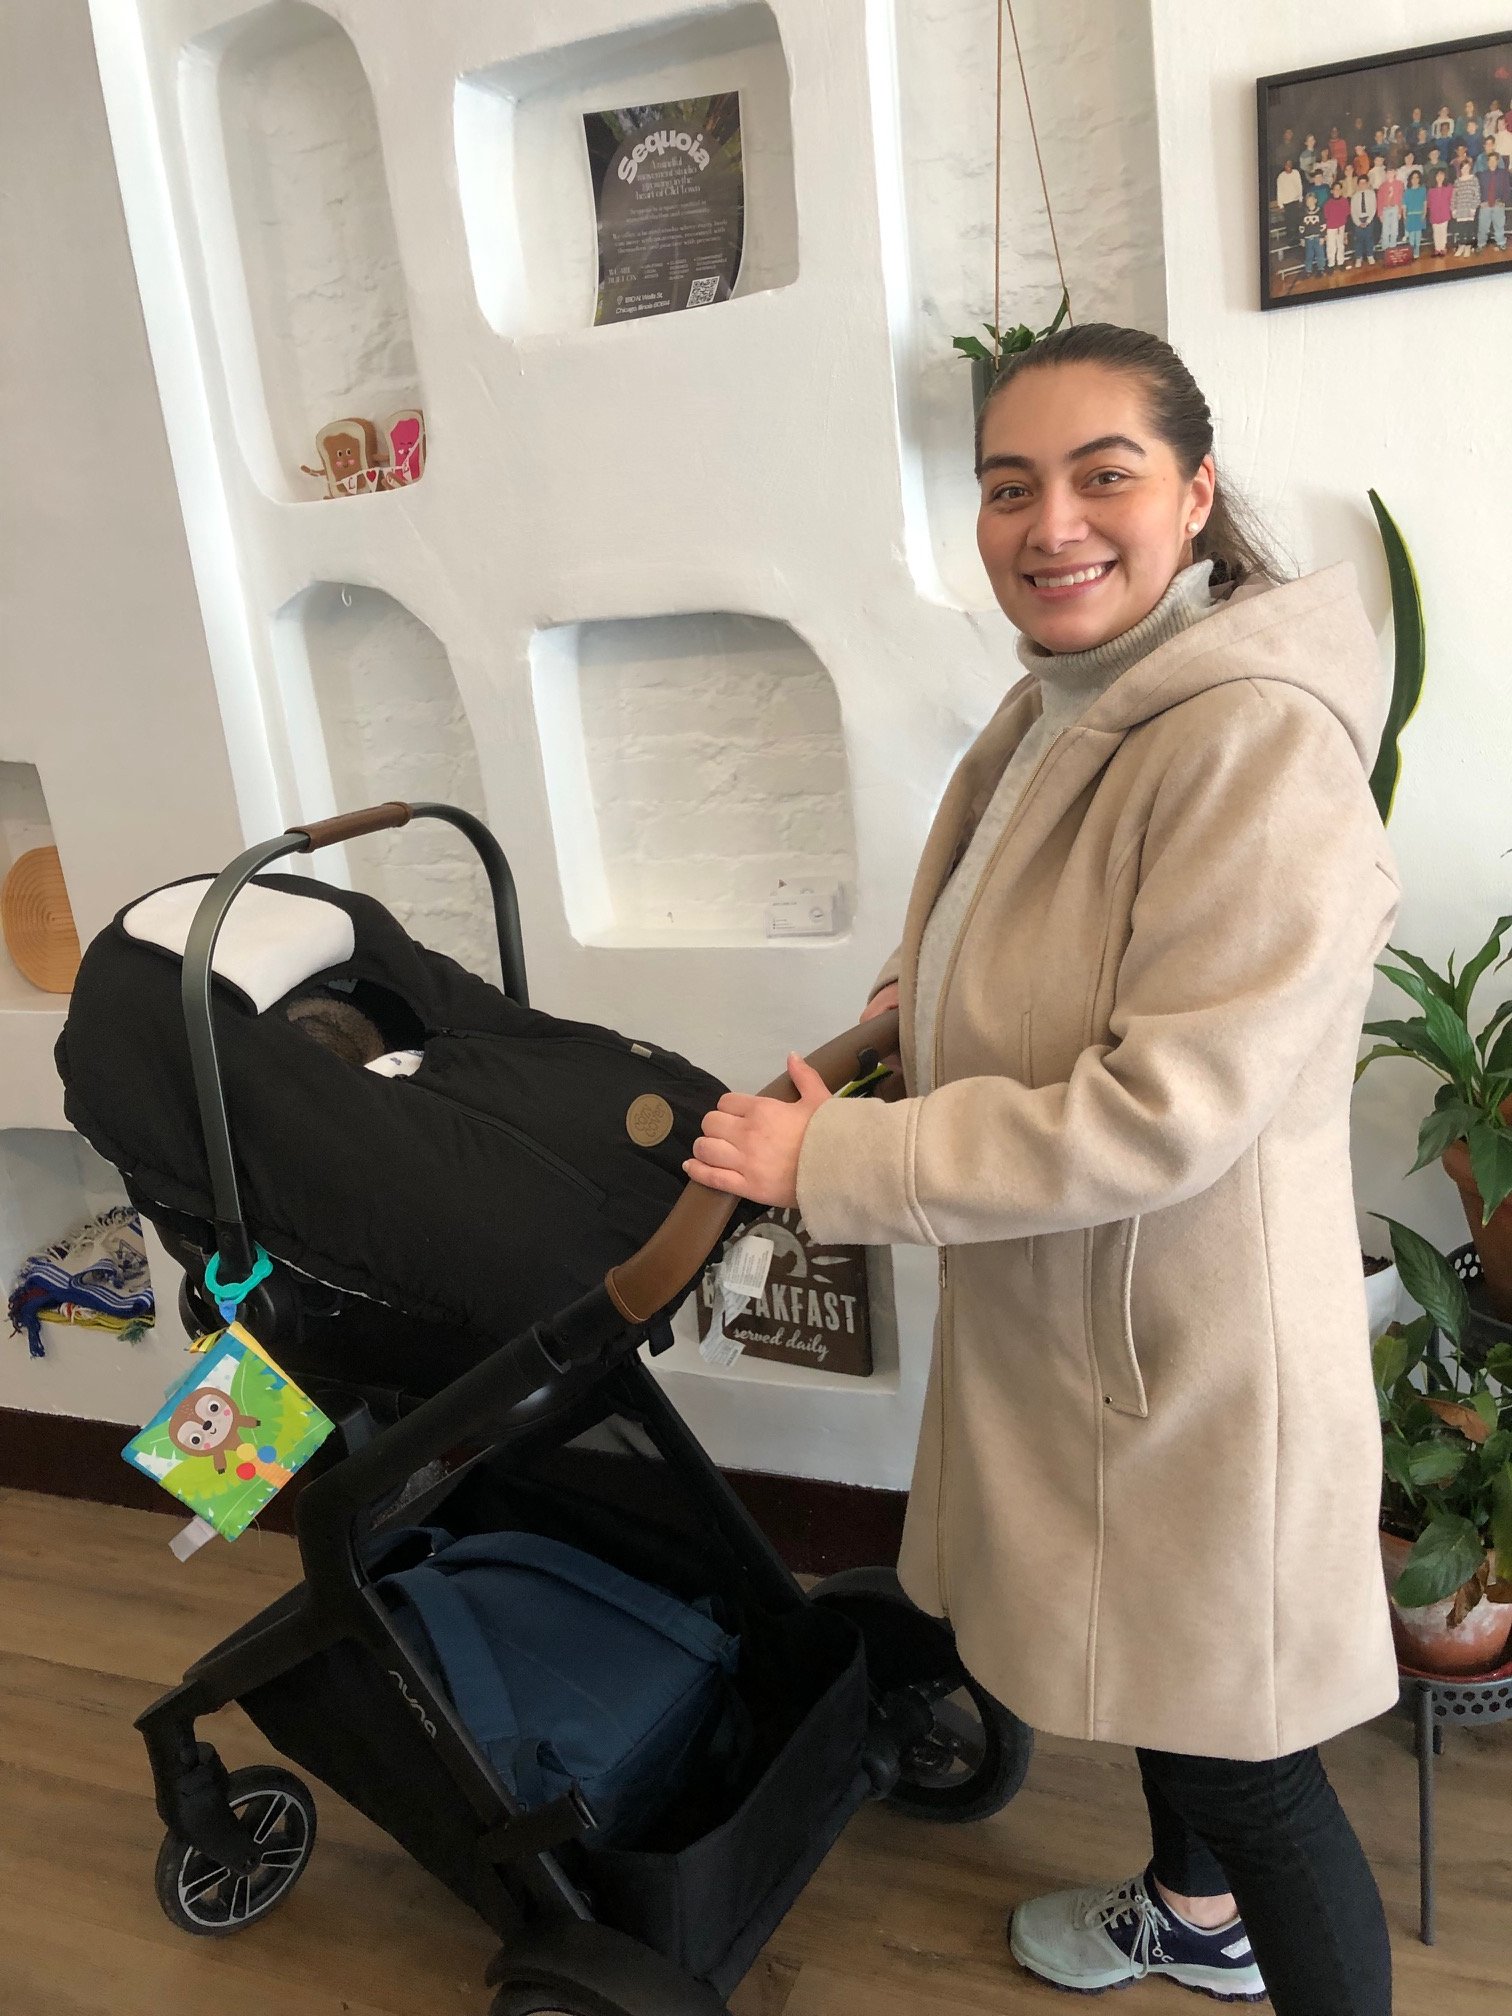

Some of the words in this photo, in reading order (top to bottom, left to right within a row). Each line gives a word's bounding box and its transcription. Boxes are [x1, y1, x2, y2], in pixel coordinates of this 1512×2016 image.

[618, 130, 710, 185] Sequoia
[702, 1271, 856, 1334] BAKFAST
[733, 1326, 783, 1347] served
[785, 1328, 830, 1362] daily
[388, 1670, 437, 1739] nuna
